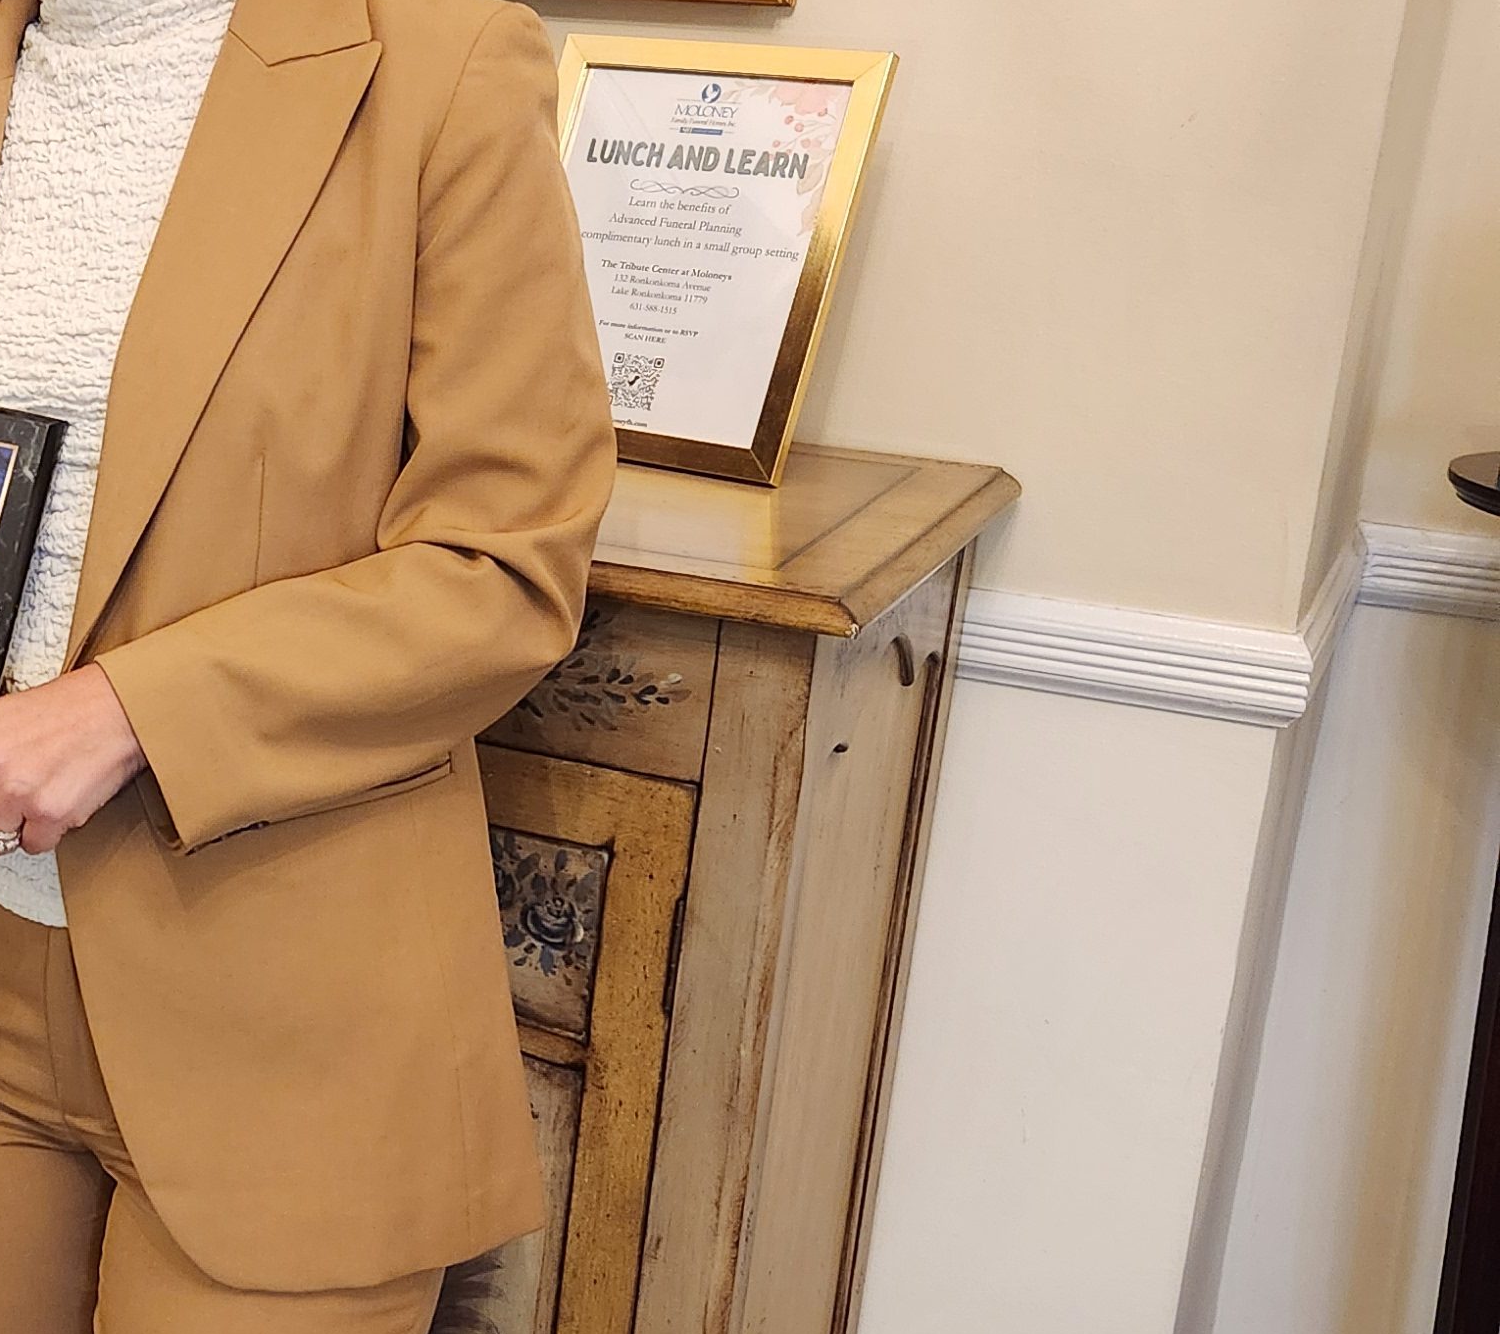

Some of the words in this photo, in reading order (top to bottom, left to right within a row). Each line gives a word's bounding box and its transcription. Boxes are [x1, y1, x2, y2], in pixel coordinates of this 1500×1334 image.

[674, 103, 739, 118] MOLONEY
[586, 138, 666, 168] LUNCH
[667, 144, 721, 173] AND
[723, 148, 810, 180] LEARN
[628, 196, 657, 209] Learn
[659, 199, 675, 210] the
[677, 202, 716, 215] benefits
[718, 204, 732, 215] of
[608, 213, 657, 227] Advanced
[659, 218, 696, 231] Funeral
[699, 221, 743, 237] Planning
[581, 231, 651, 247] complimentary
[654, 235, 681, 248] lunch
[683, 238, 693, 249] in
[695, 242, 701, 250] a
[704, 241, 731, 253] small
[731, 245, 763, 259] group
[766, 247, 800, 261] setting
[601, 259, 618, 269] The
[619, 261, 650, 272] Tribute
[651, 264, 680, 275] Center
[691, 268, 732, 283] Moloneys
[629, 275, 680, 289] Ronkonkoma
[682, 281, 712, 292] Avenue
[611, 286, 629, 296] Lake
[631, 287, 682, 302] Ronkonkoma
[684, 294, 709, 305] 11779
[624, 333, 644, 342] SCAN
[645, 334, 667, 344] HERE
[680, 328, 699, 338] RSVP
